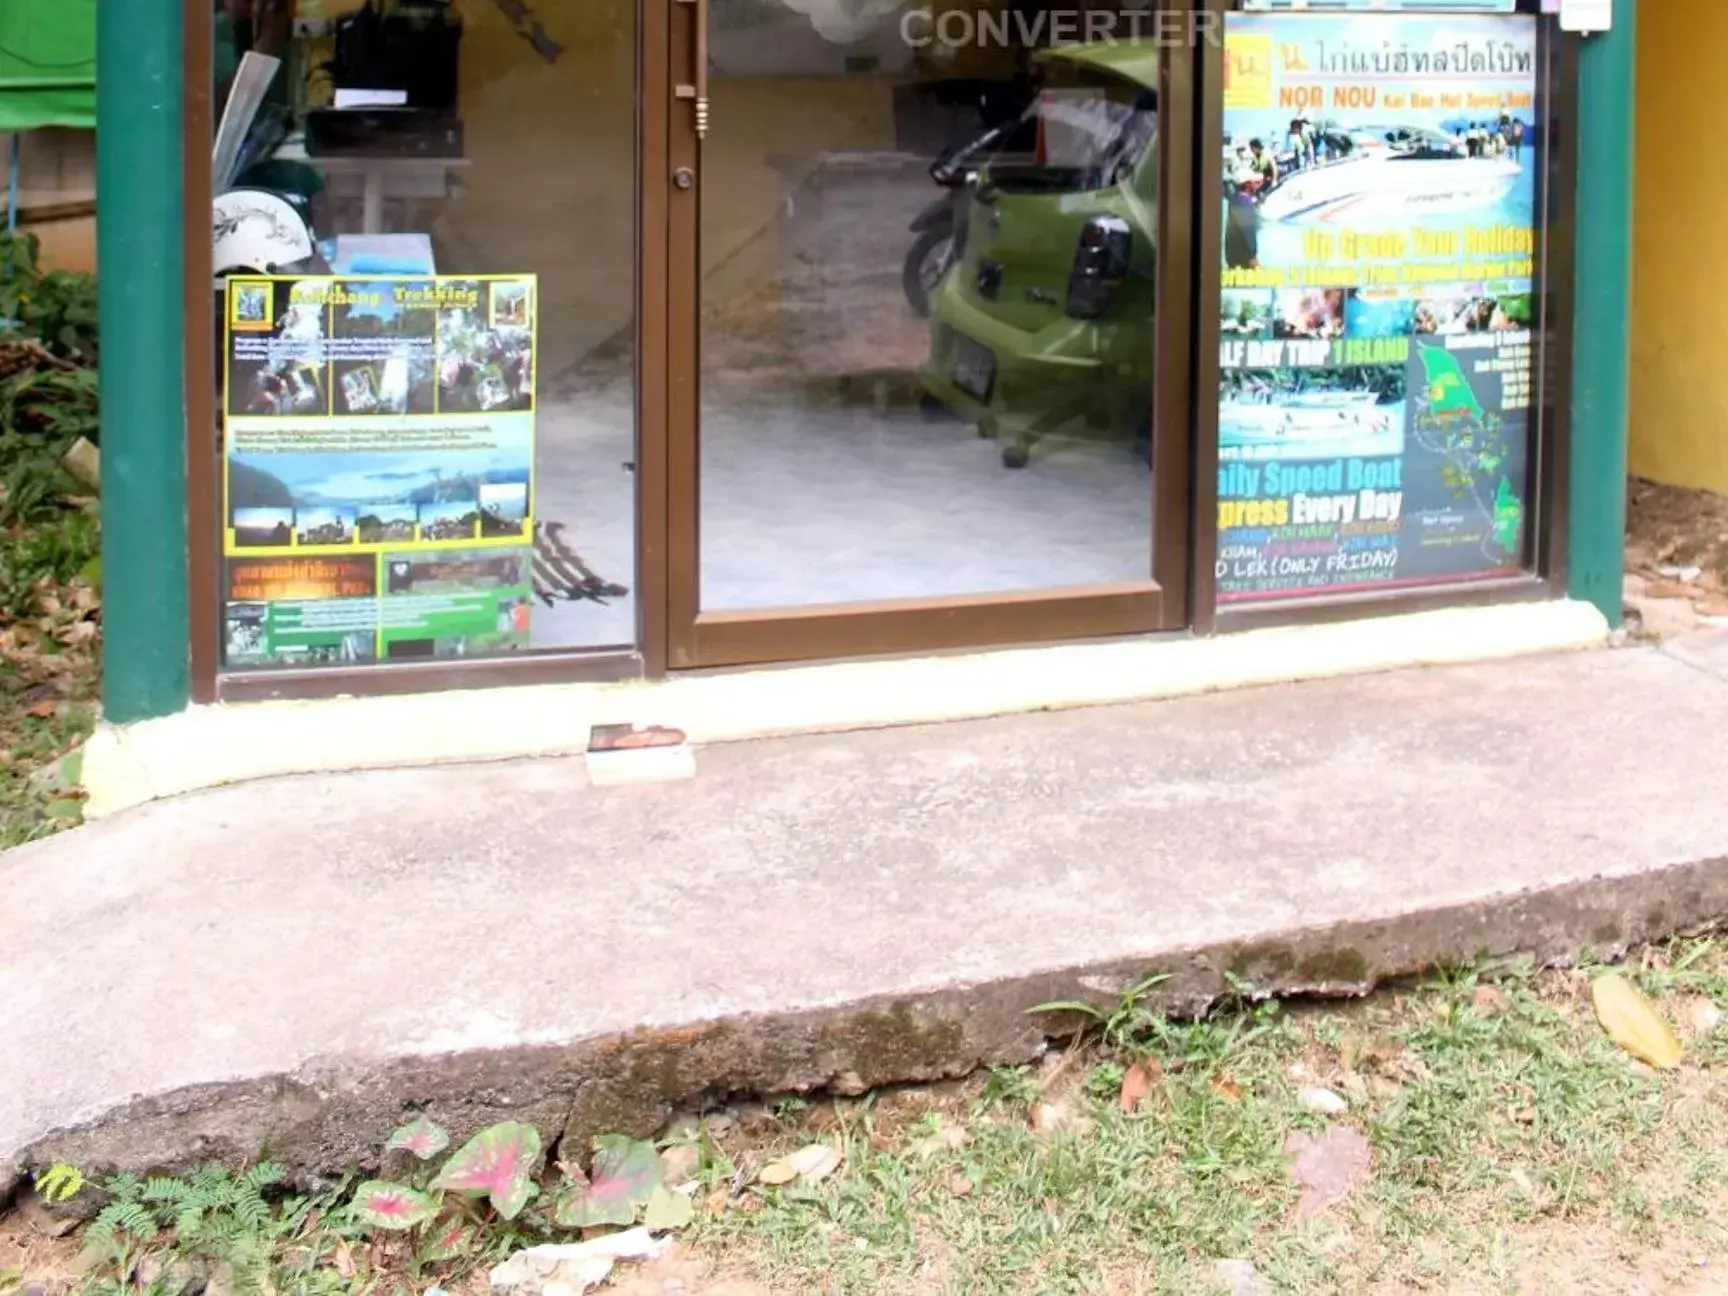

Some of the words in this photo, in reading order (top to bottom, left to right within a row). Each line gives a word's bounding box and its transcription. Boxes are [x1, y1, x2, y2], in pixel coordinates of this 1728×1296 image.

[1345, 336, 1409, 364] ISLAND
[1263, 461, 1344, 496] Speed
[1347, 458, 1402, 490] Boat
[1291, 492, 1358, 525] Every
[1357, 489, 1402, 522] Day
